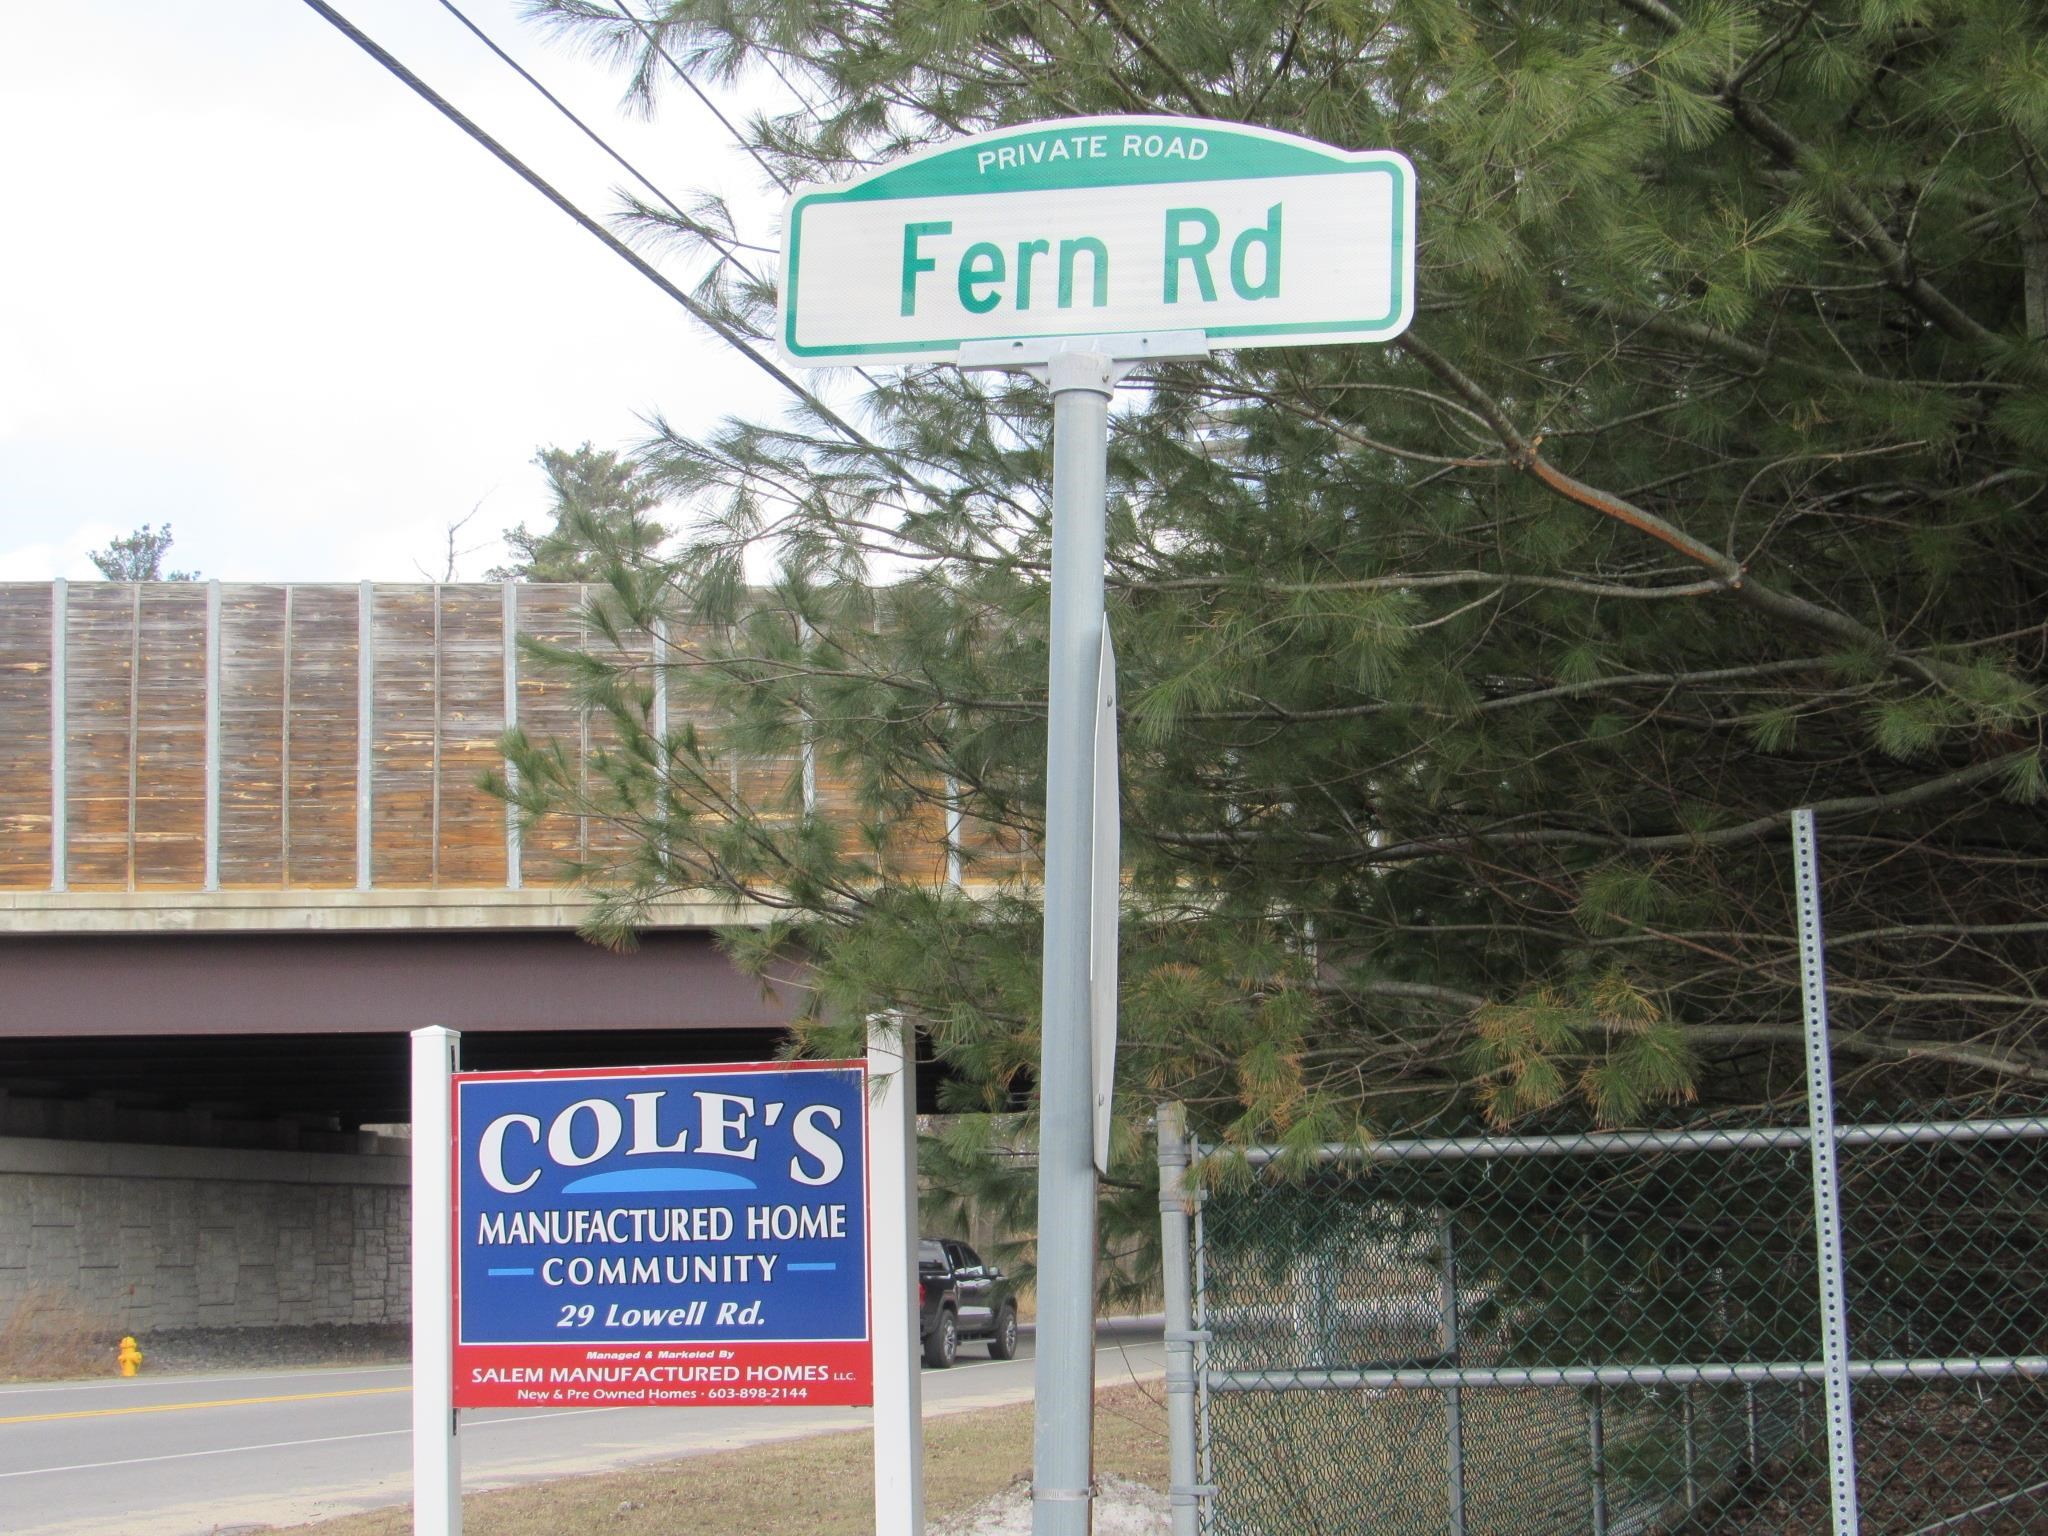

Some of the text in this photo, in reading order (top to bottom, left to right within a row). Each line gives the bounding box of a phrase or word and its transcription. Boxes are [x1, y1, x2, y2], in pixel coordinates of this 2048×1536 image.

[978, 134, 1210, 175] PRIVATE ROAD
[900, 201, 1283, 318] Fern Rd
[478, 1091, 844, 1194] COLE'S
[477, 1204, 847, 1245] MANUFACTURED HOME
[542, 1255, 779, 1286] COMMUNITY
[556, 1301, 766, 1328] 29 Lowell Rd.
[586, 1350, 641, 1361] Managed
[658, 1349, 714, 1360] Marketed
[718, 1350, 735, 1360] By
[471, 1367, 543, 1384] SALEM
[549, 1366, 741, 1383] MANUFACTURED
[746, 1365, 829, 1381] HOMES
[517, 1387, 808, 1400] New & Pre Owned Homes 603-898-2144
